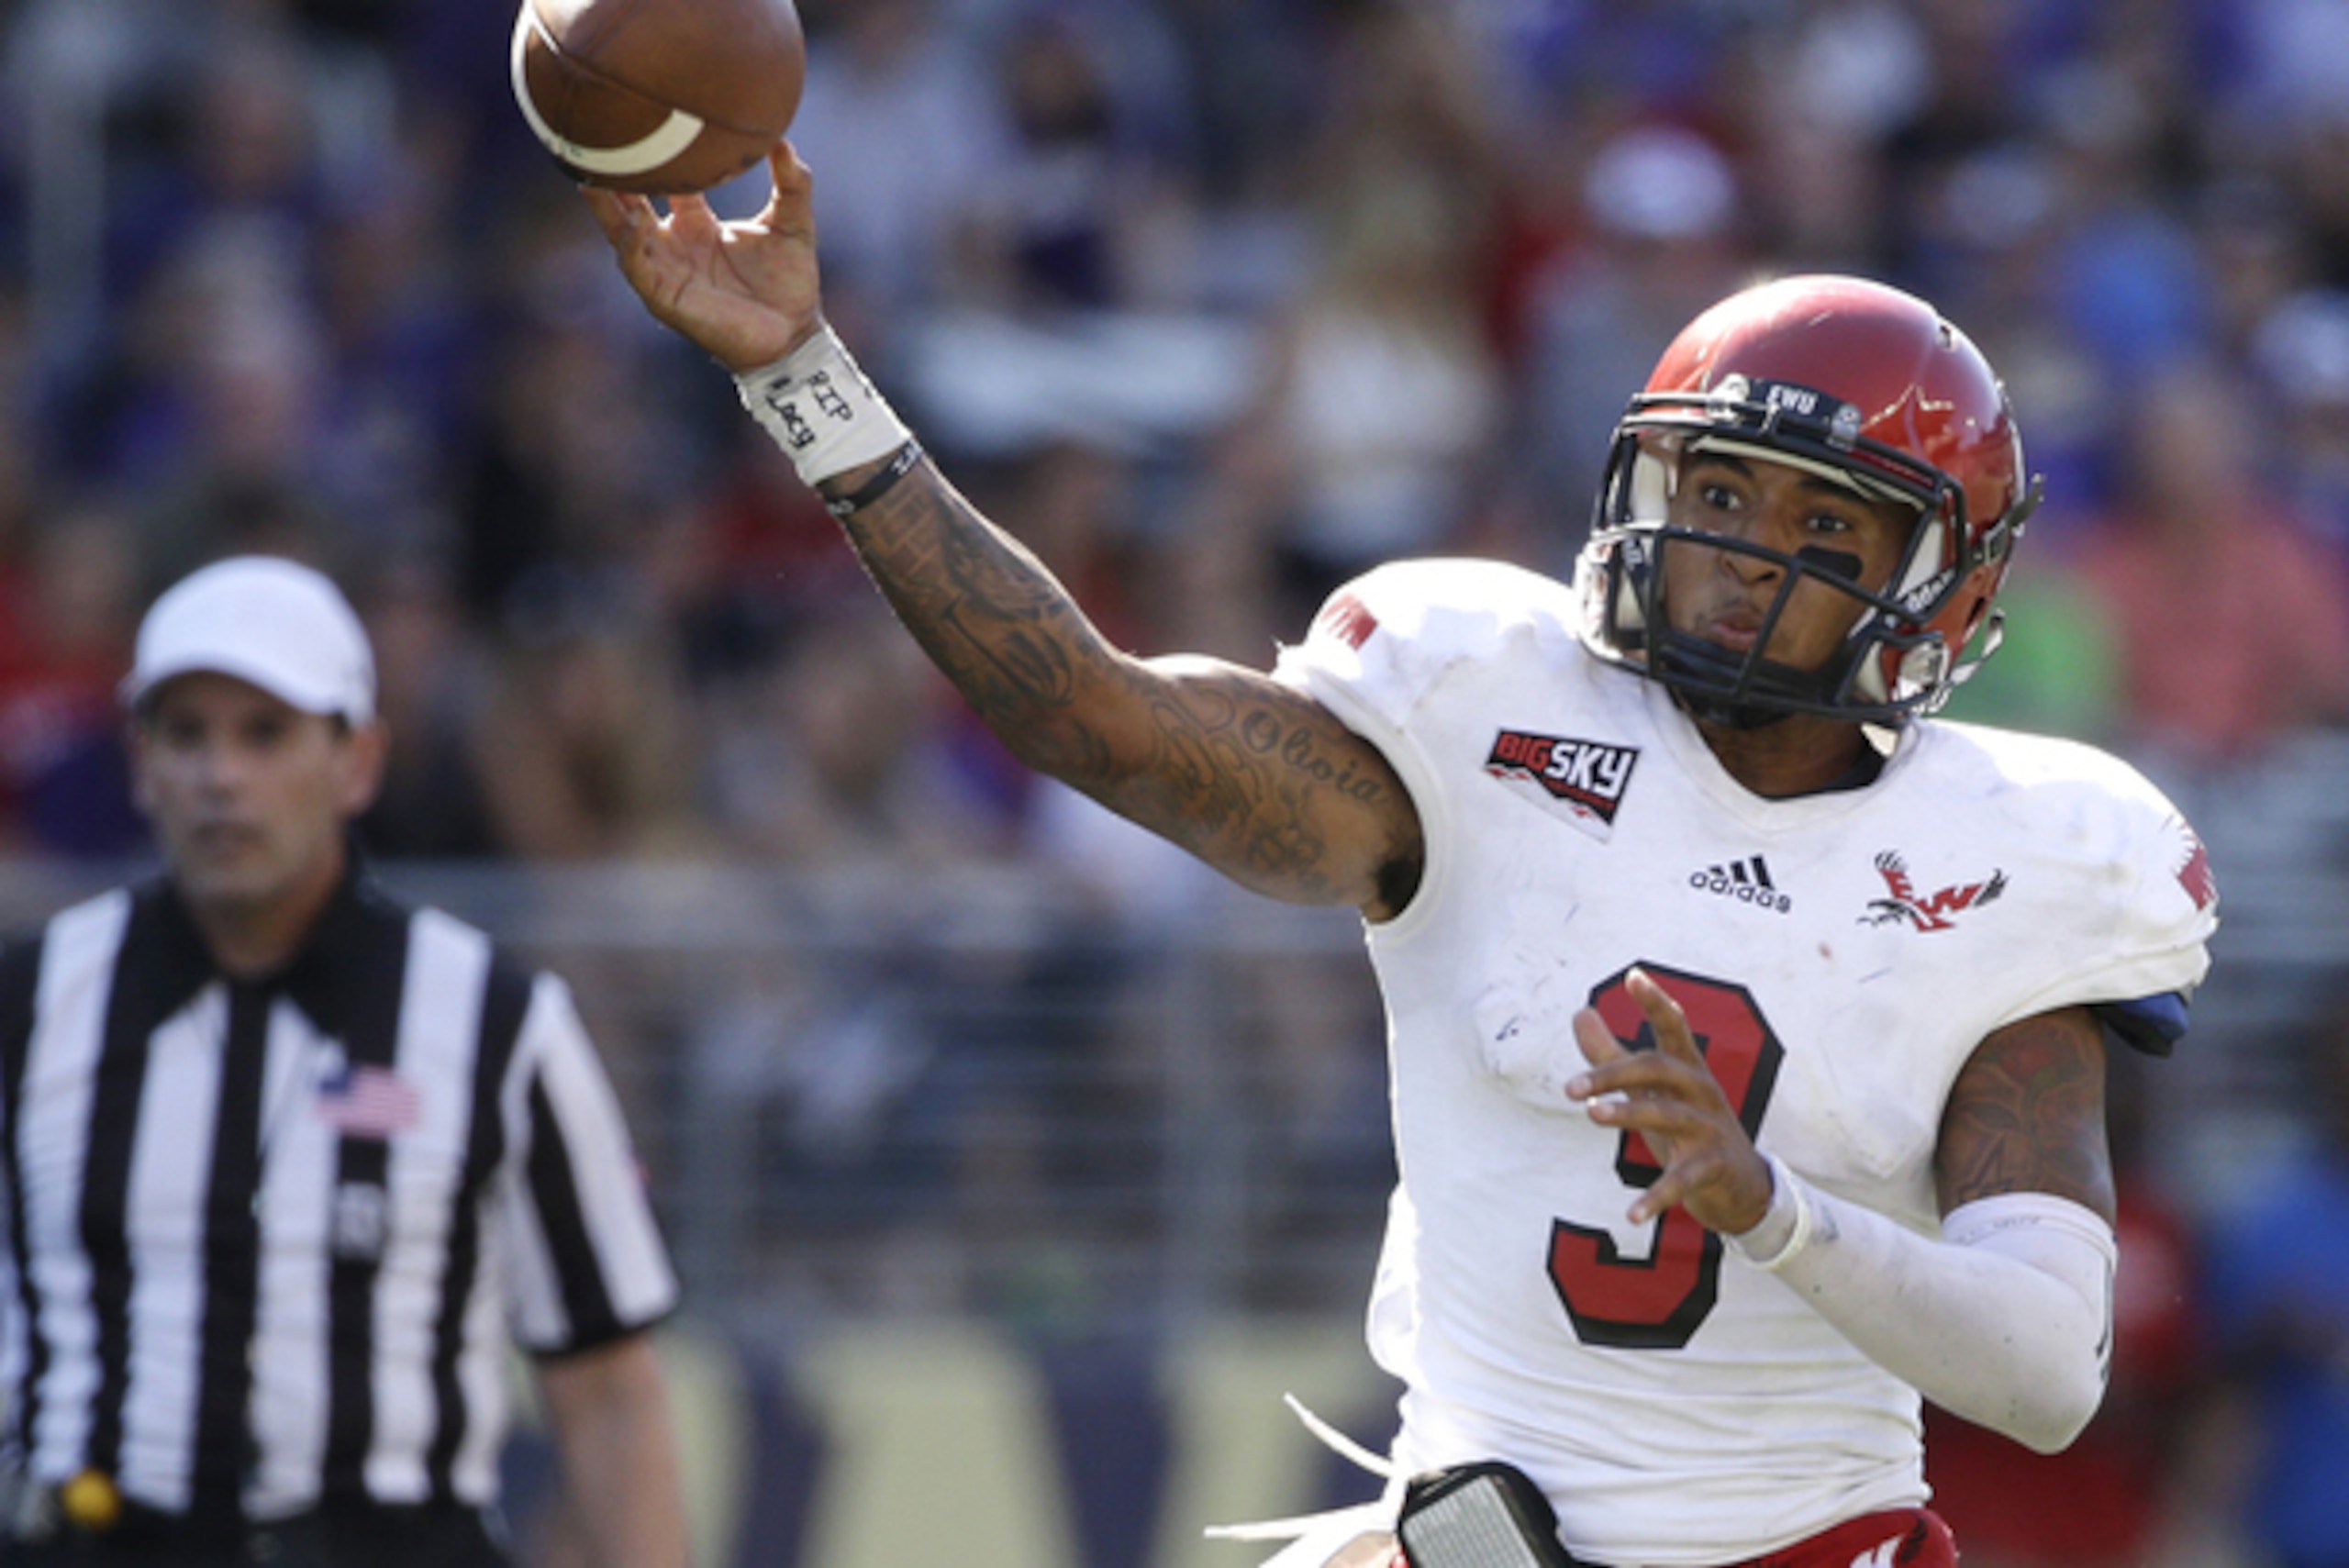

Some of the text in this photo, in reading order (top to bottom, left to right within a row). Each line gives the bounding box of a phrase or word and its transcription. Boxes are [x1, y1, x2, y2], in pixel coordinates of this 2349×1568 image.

[803, 370, 853, 421] RIP
[1766, 384, 1819, 415] EWU
[1689, 872, 1791, 914] adidas
[1547, 959, 1786, 1349] 3
